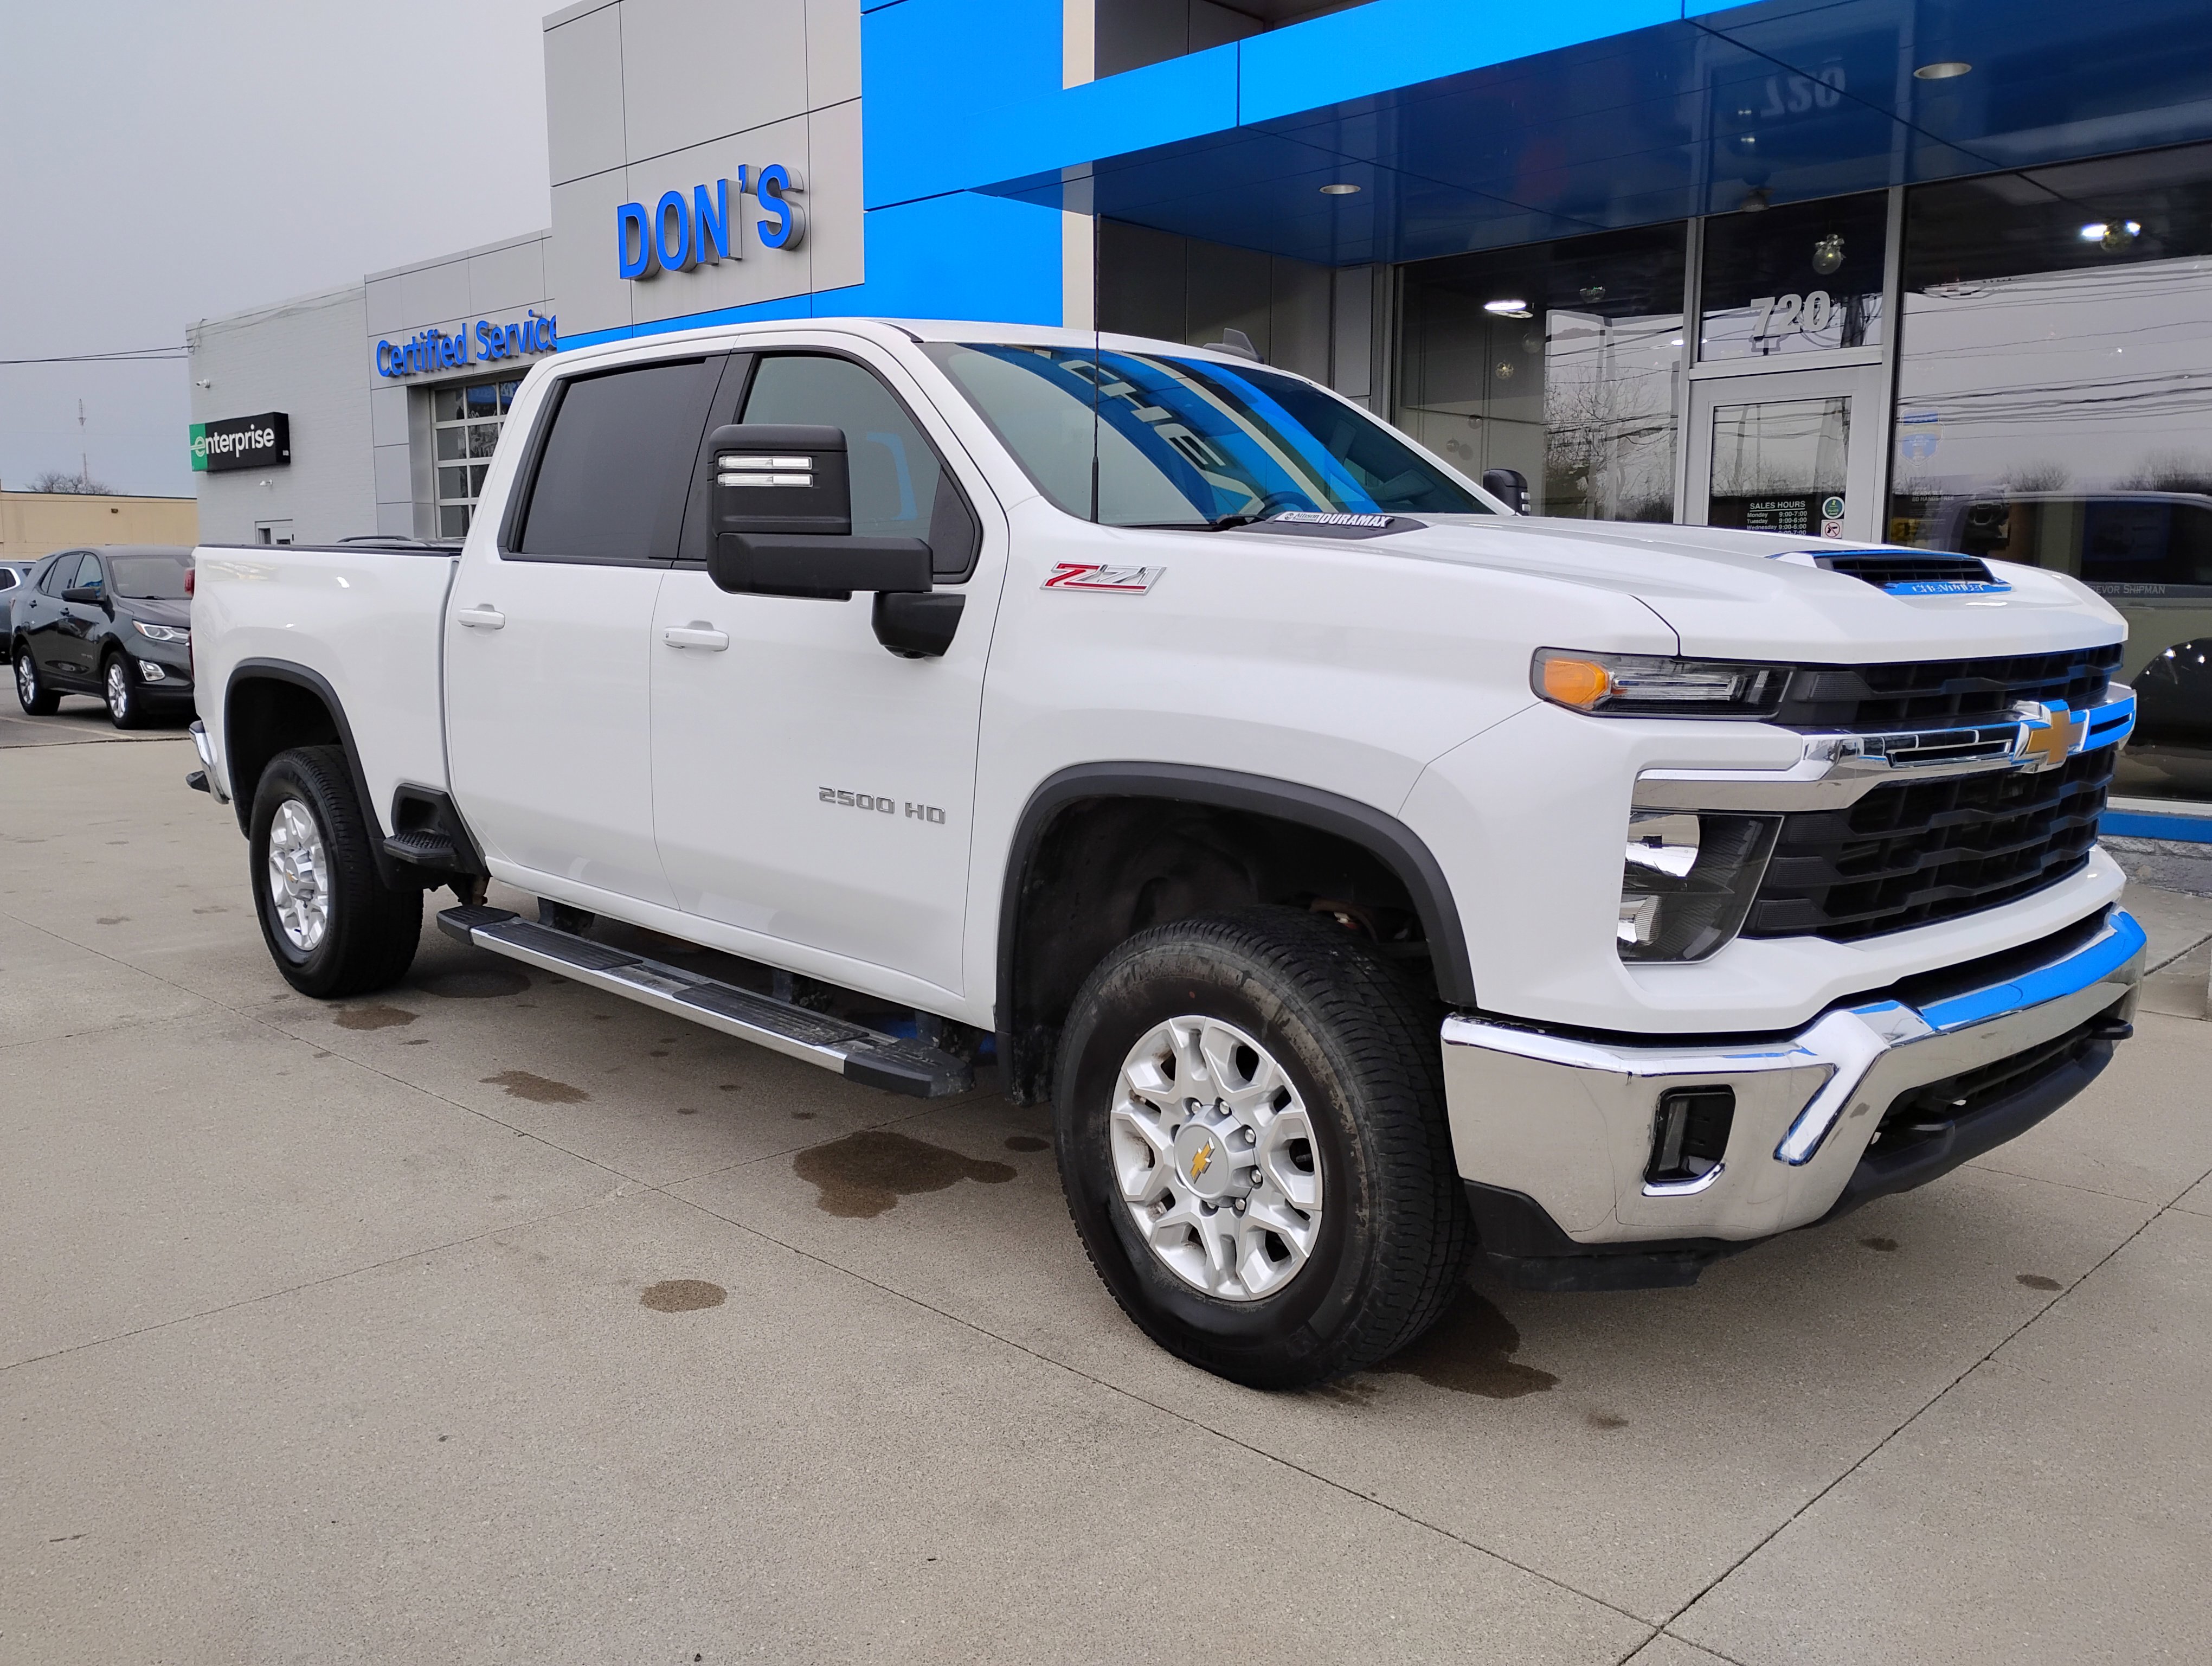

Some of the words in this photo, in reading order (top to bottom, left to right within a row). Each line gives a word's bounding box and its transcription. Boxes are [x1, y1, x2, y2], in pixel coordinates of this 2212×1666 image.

[617, 164, 801, 280] DON'S
[1751, 291, 1830, 337] 720
[376, 323, 468, 377] Certified
[191, 424, 274, 458] enterprise
[1319, 513, 1393, 528] DURAMAX
[1750, 502, 1776, 510] SALES
[1777, 501, 1806, 509] HOURS
[1039, 561, 1167, 596] Z71
[2123, 584, 2165, 594] SHIPMAN
[819, 786, 895, 814] 2500
[905, 801, 946, 824] HD
